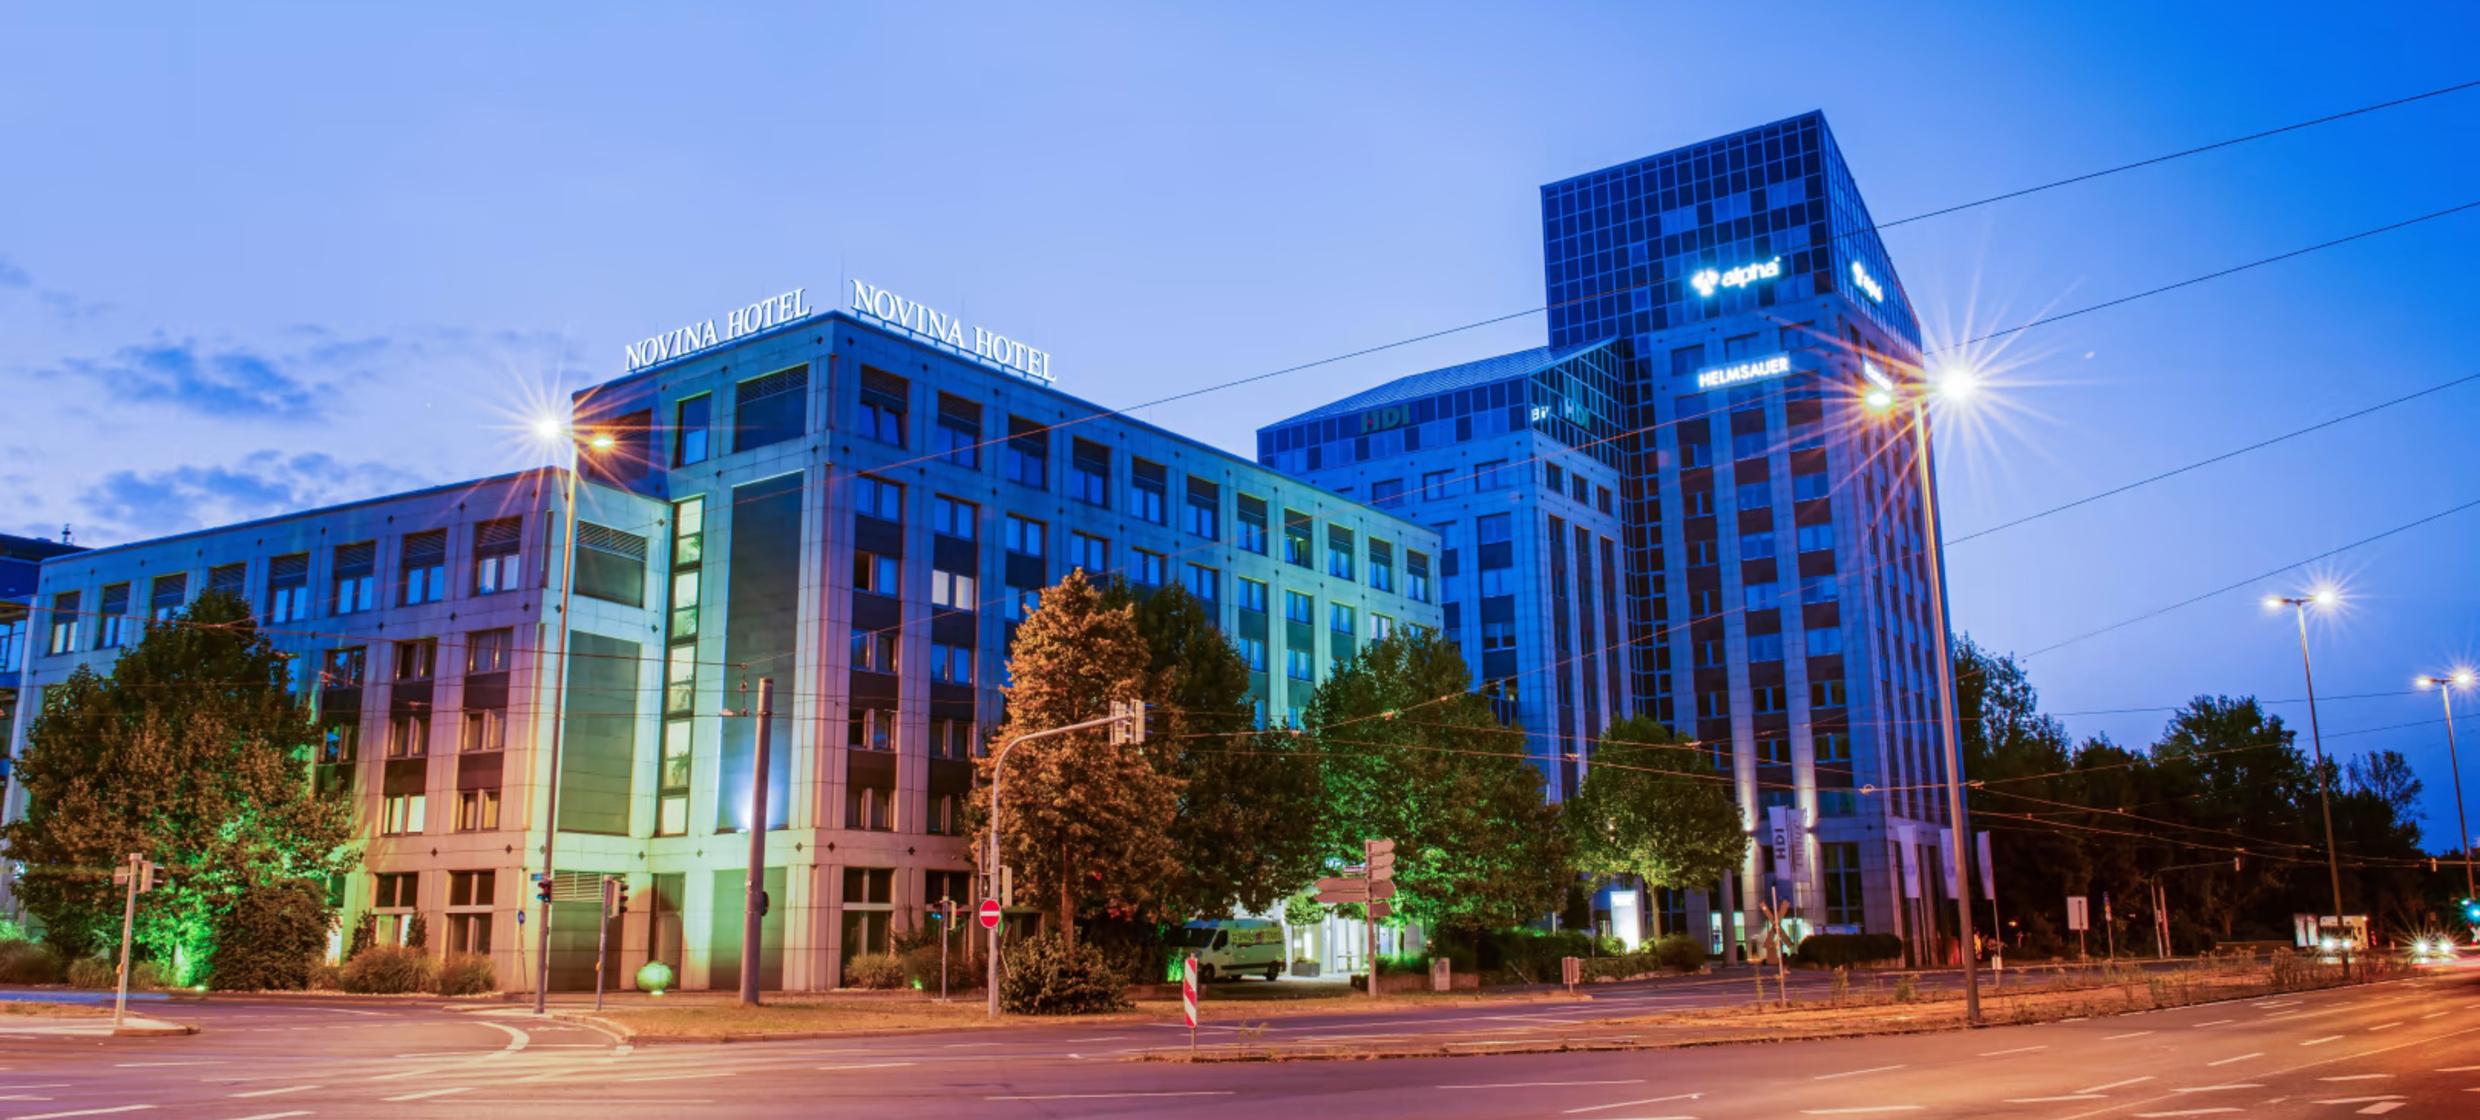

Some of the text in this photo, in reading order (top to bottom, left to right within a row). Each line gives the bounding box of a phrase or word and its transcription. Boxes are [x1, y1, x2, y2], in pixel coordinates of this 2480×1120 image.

[1721, 260, 1779, 288] alpha
[625, 289, 811, 371] NOVINA HOTEL
[851, 279, 1057, 382] NOVINA HOTEL
[1698, 356, 1789, 388] HELMSAUER
[1360, 405, 1411, 433] HDI
[1775, 828, 1786, 859] HDI
